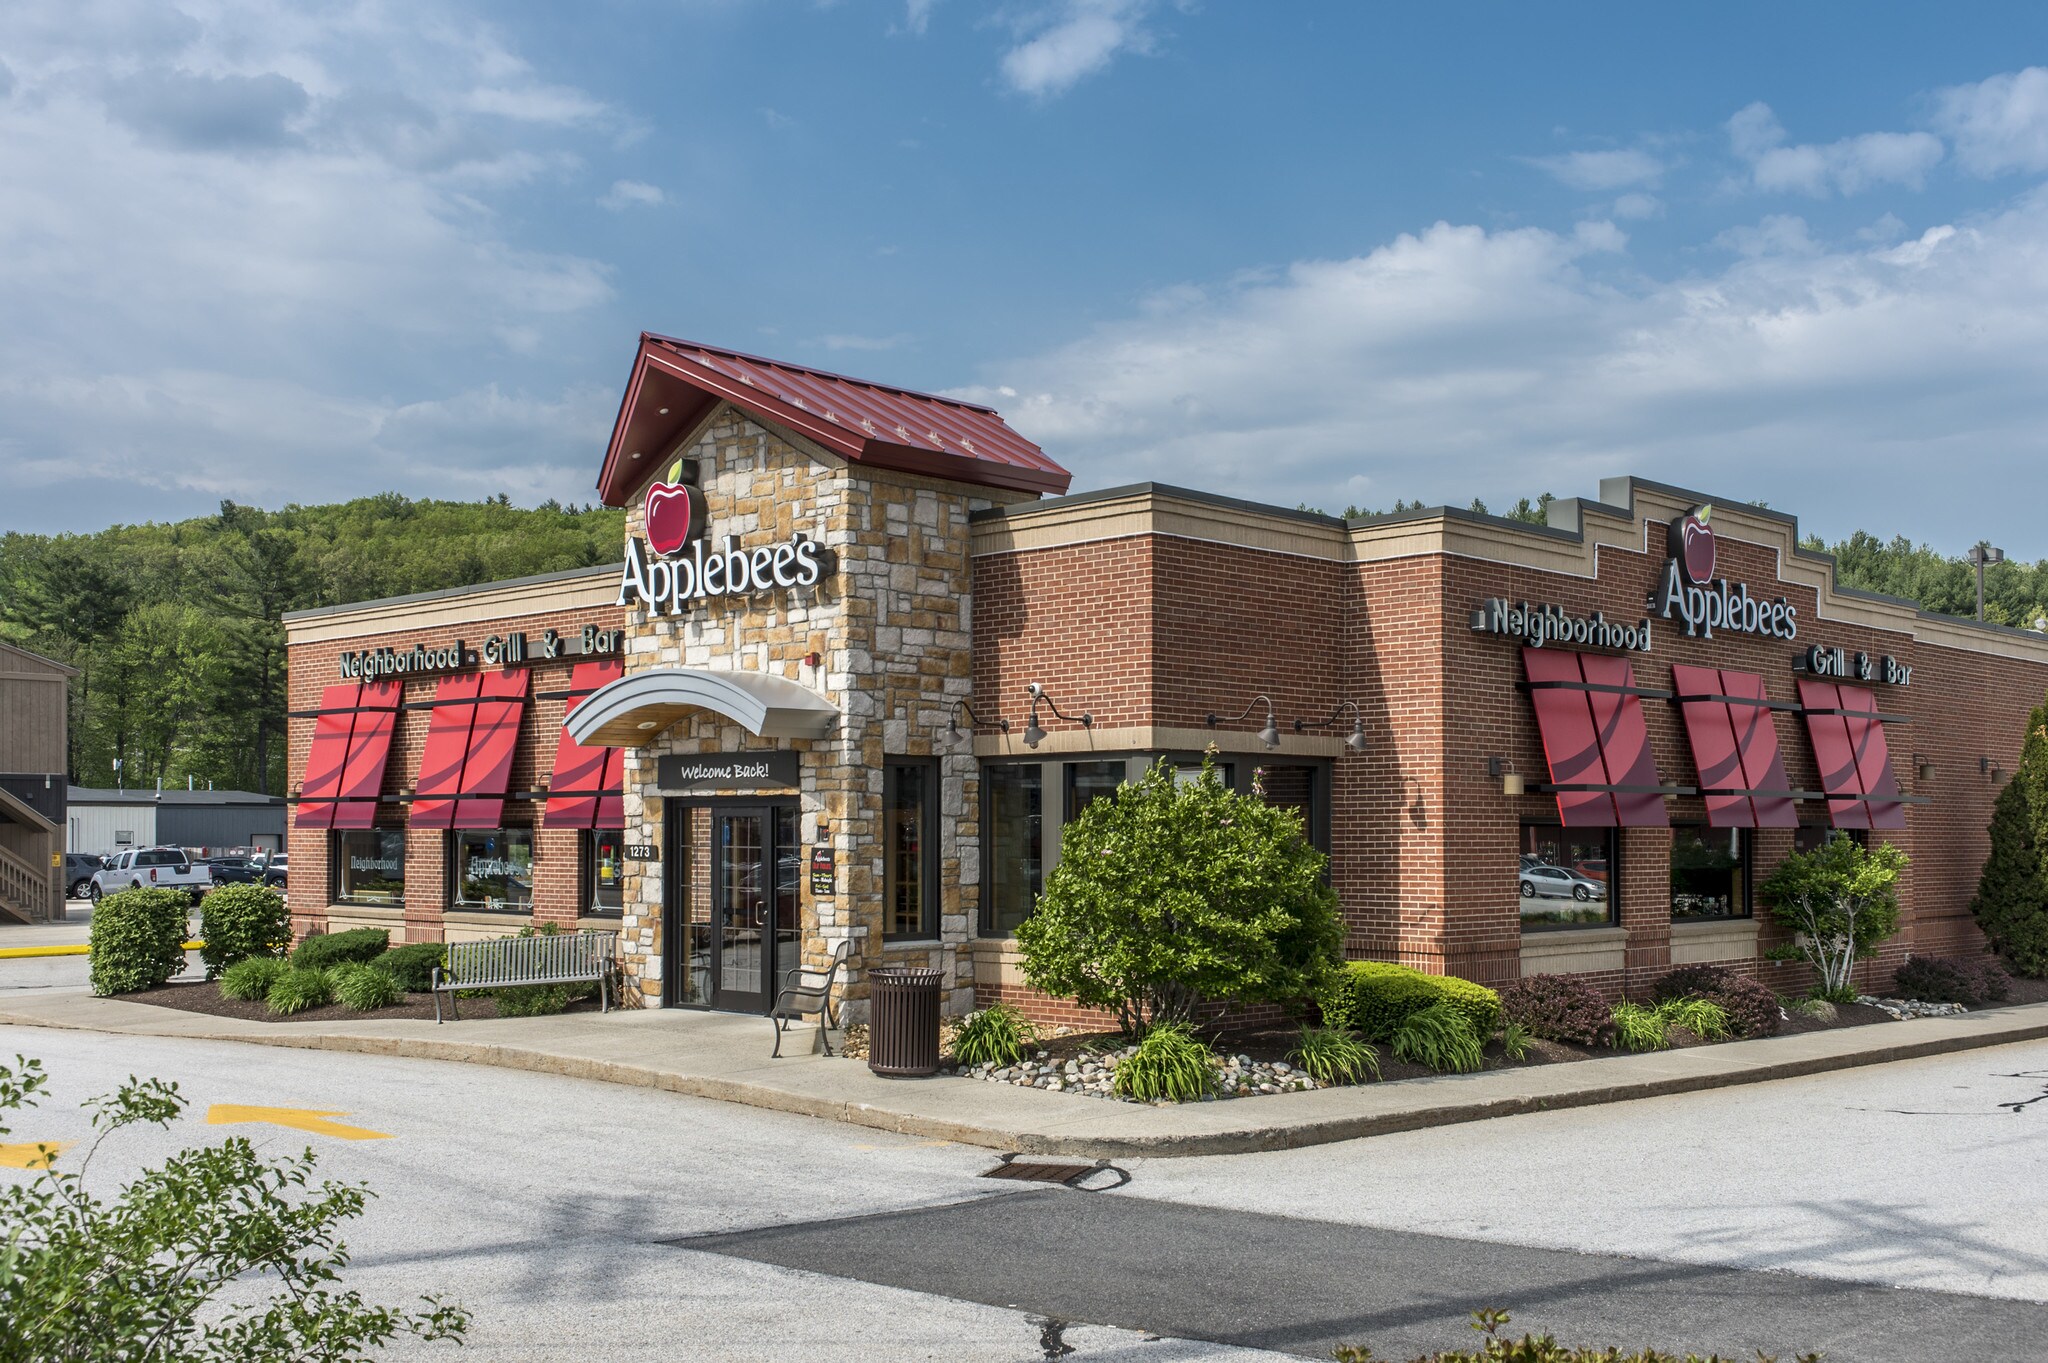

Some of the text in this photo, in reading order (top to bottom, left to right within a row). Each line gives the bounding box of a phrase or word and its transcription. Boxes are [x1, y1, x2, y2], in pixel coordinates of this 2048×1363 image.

[616, 533, 820, 617] Applebee's
[1663, 557, 1797, 641] Applebee's
[1493, 597, 1651, 651] Neighborhood
[339, 624, 619, 683] Neighborhood Grill & Bar
[1813, 644, 1913, 686] Grill & Bar
[681, 761, 769, 779] Welcome Back!
[351, 855, 398, 871] Neighborhood
[630, 846, 650, 857] 1273
